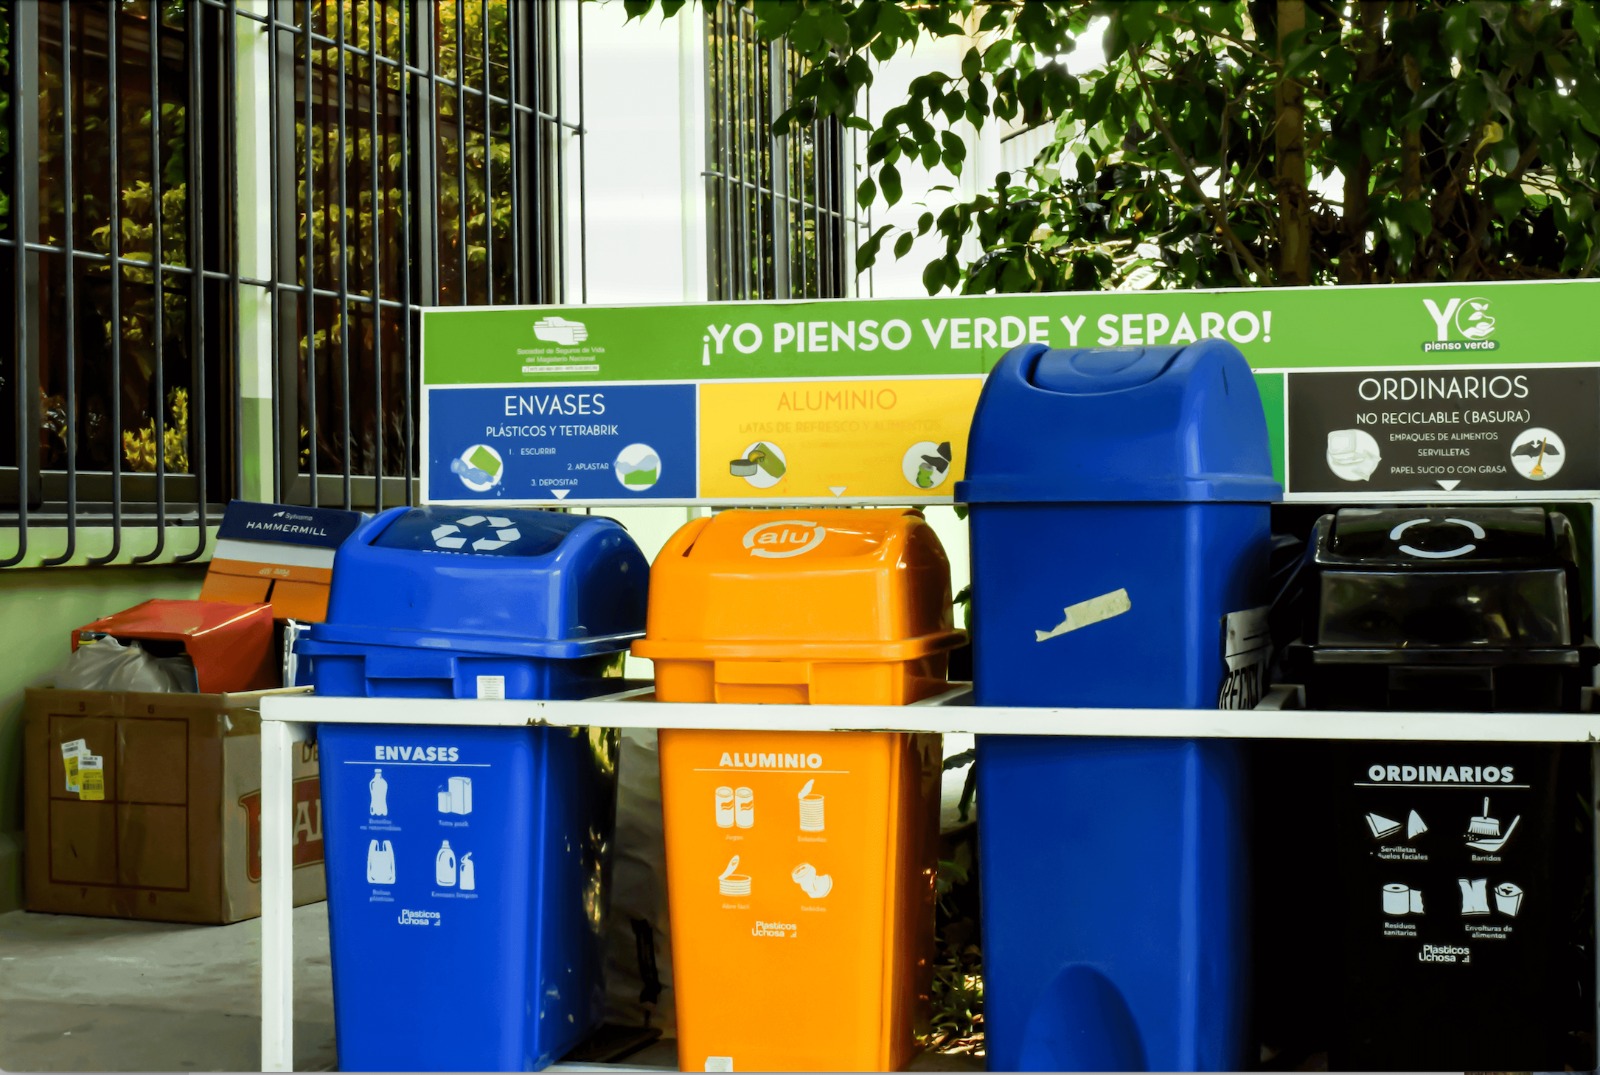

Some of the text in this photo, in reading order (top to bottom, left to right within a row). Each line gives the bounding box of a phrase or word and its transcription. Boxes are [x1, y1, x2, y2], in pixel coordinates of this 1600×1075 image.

[702, 310, 1272, 366] ¡YO PIENSO VERDE Y SEPARO!
[1424, 340, 1495, 353] pienso verde
[1358, 375, 1530, 401] ORDINARIOS
[504, 393, 606, 417] ENVASES
[777, 388, 897, 412] ALUMINIO
[1356, 409, 1531, 425] NO RECICLABLE (BASURA)
[485, 422, 619, 438] PLÁSTICOS Y TETRABRIK
[739, 421, 773, 434] LATAS
[776, 421, 791, 433] DE
[1389, 433, 1435, 442] EMPAQUES
[1450, 432, 1498, 440] ALIMENTOS
[520, 447, 557, 456] ESCURRIR
[1417, 448, 1470, 457] SERVILLETAS
[575, 462, 609, 471] APLASTAR
[1390, 465, 1507, 474] PAPEL SUCIO O CON GRASA
[538, 478, 579, 487] DEPOSITAR
[245, 521, 328, 536] HAMMERMILL
[756, 529, 809, 545] alu
[374, 745, 460, 762] ENVASES
[719, 752, 823, 769] ALUMINIO
[1368, 765, 1514, 783] ORDINARIOS
[398, 916, 429, 925] Uchosa
[1384, 922, 1416, 930] Residuos
[752, 928, 785, 937] Uchosa
[1418, 952, 1456, 962] Uchosa
